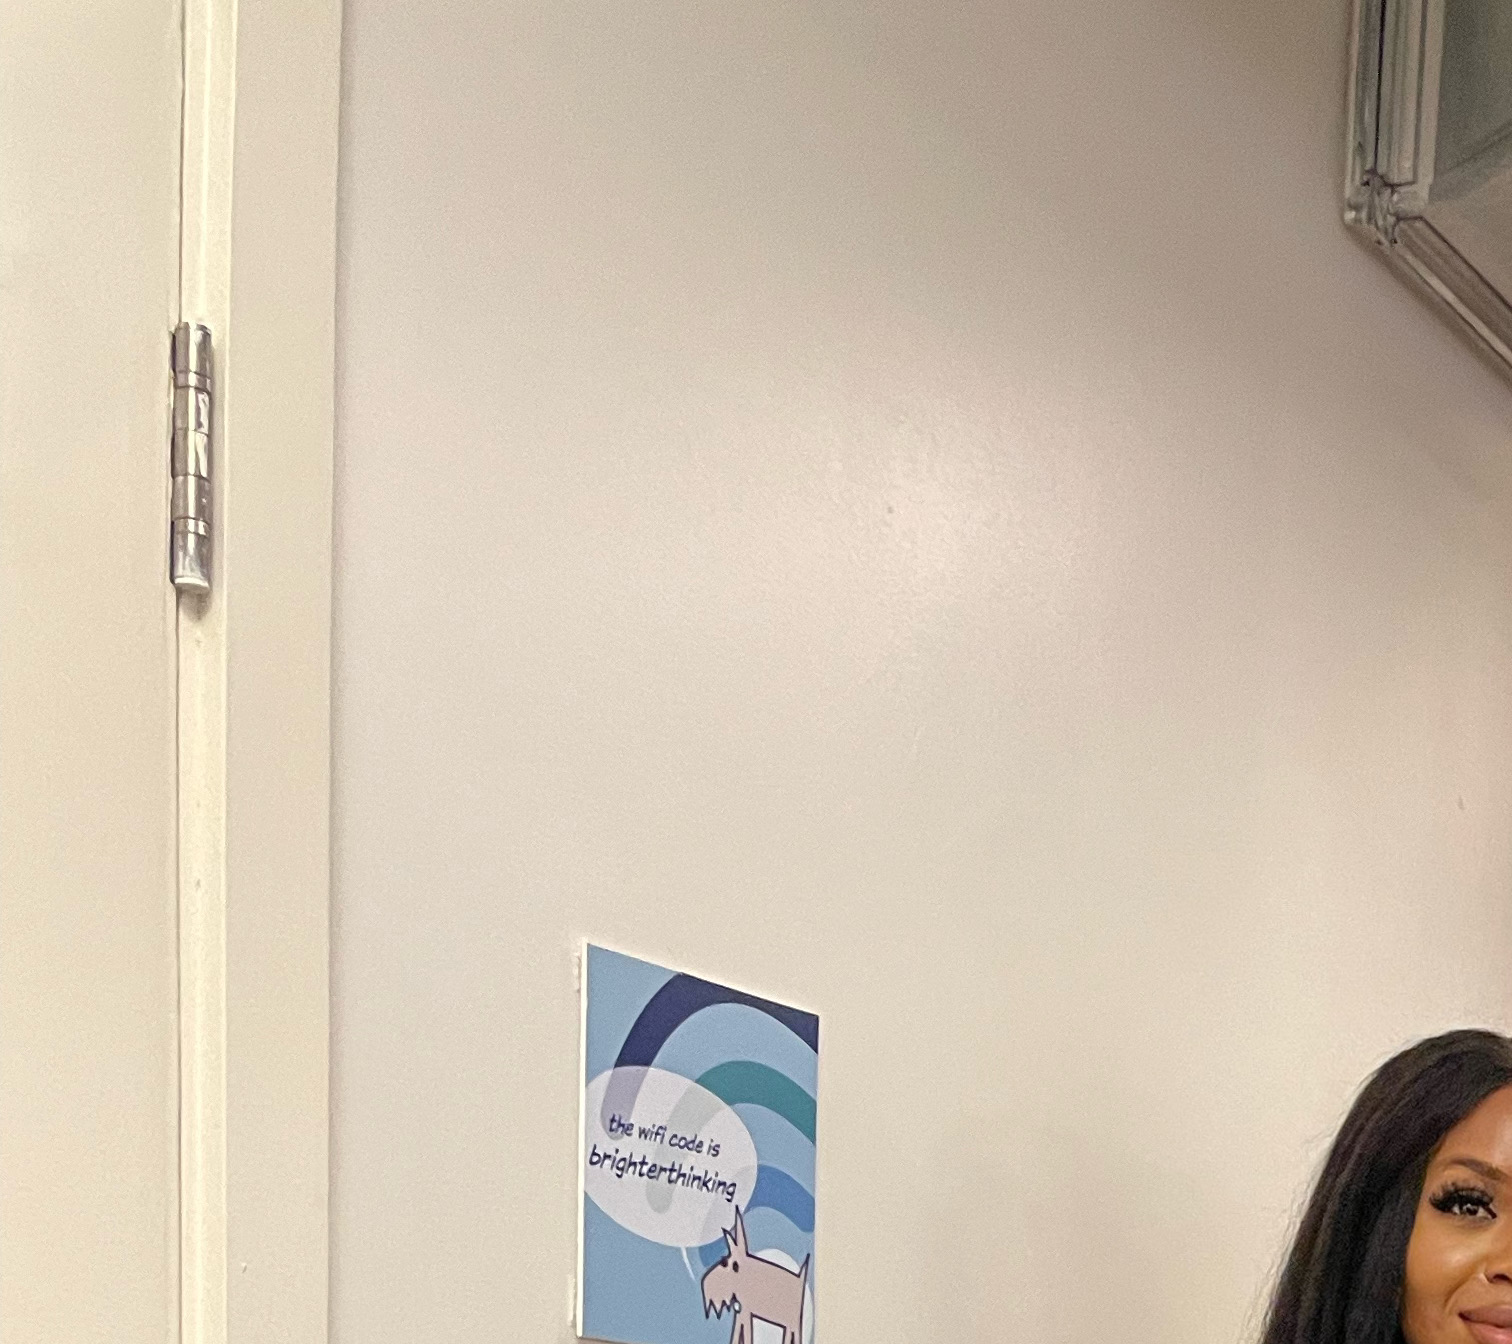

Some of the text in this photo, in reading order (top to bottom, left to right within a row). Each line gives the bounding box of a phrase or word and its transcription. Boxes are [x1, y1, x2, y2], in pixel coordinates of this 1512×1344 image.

[608, 1114, 721, 1157] the wifi code is
[589, 1143, 737, 1202] brighterthinking
